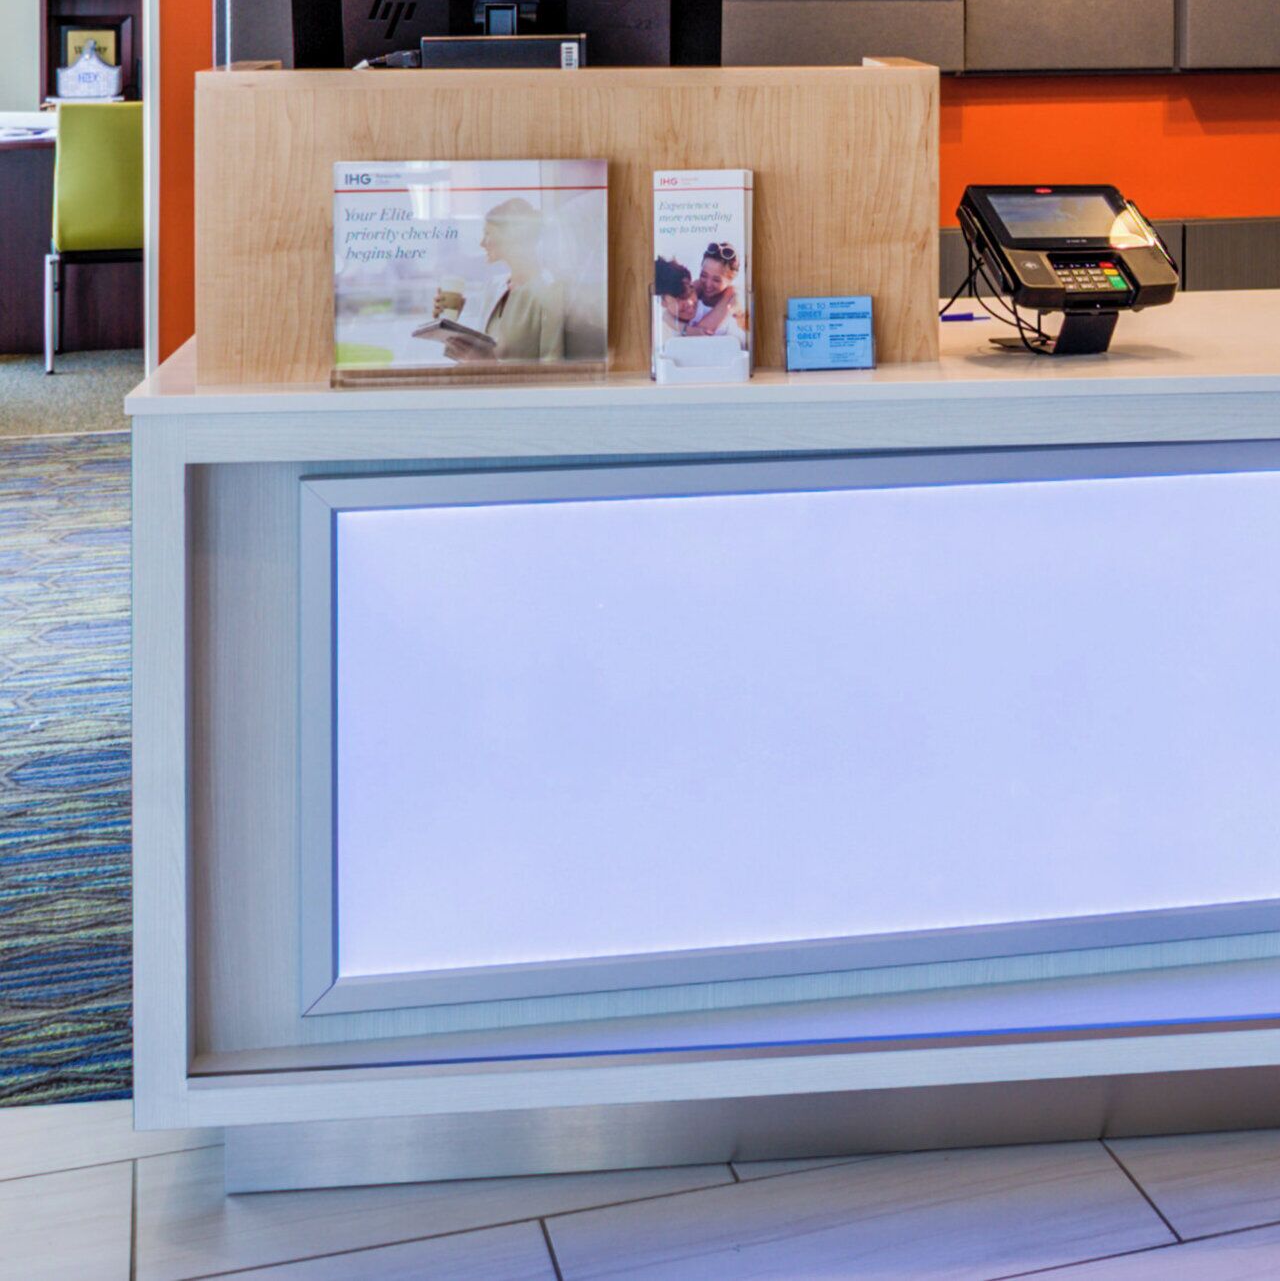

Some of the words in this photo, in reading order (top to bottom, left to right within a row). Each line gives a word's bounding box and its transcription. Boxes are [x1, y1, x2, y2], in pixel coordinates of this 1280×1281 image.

[344, 173, 372, 185] IHG
[660, 177, 678, 185] IHG
[344, 207, 377, 222] Your
[380, 207, 414, 222] Elite
[345, 227, 399, 244] priority
[659, 226, 677, 236] way
[690, 223, 719, 233] travel
[345, 246, 392, 263] begins
[395, 246, 427, 259] here
